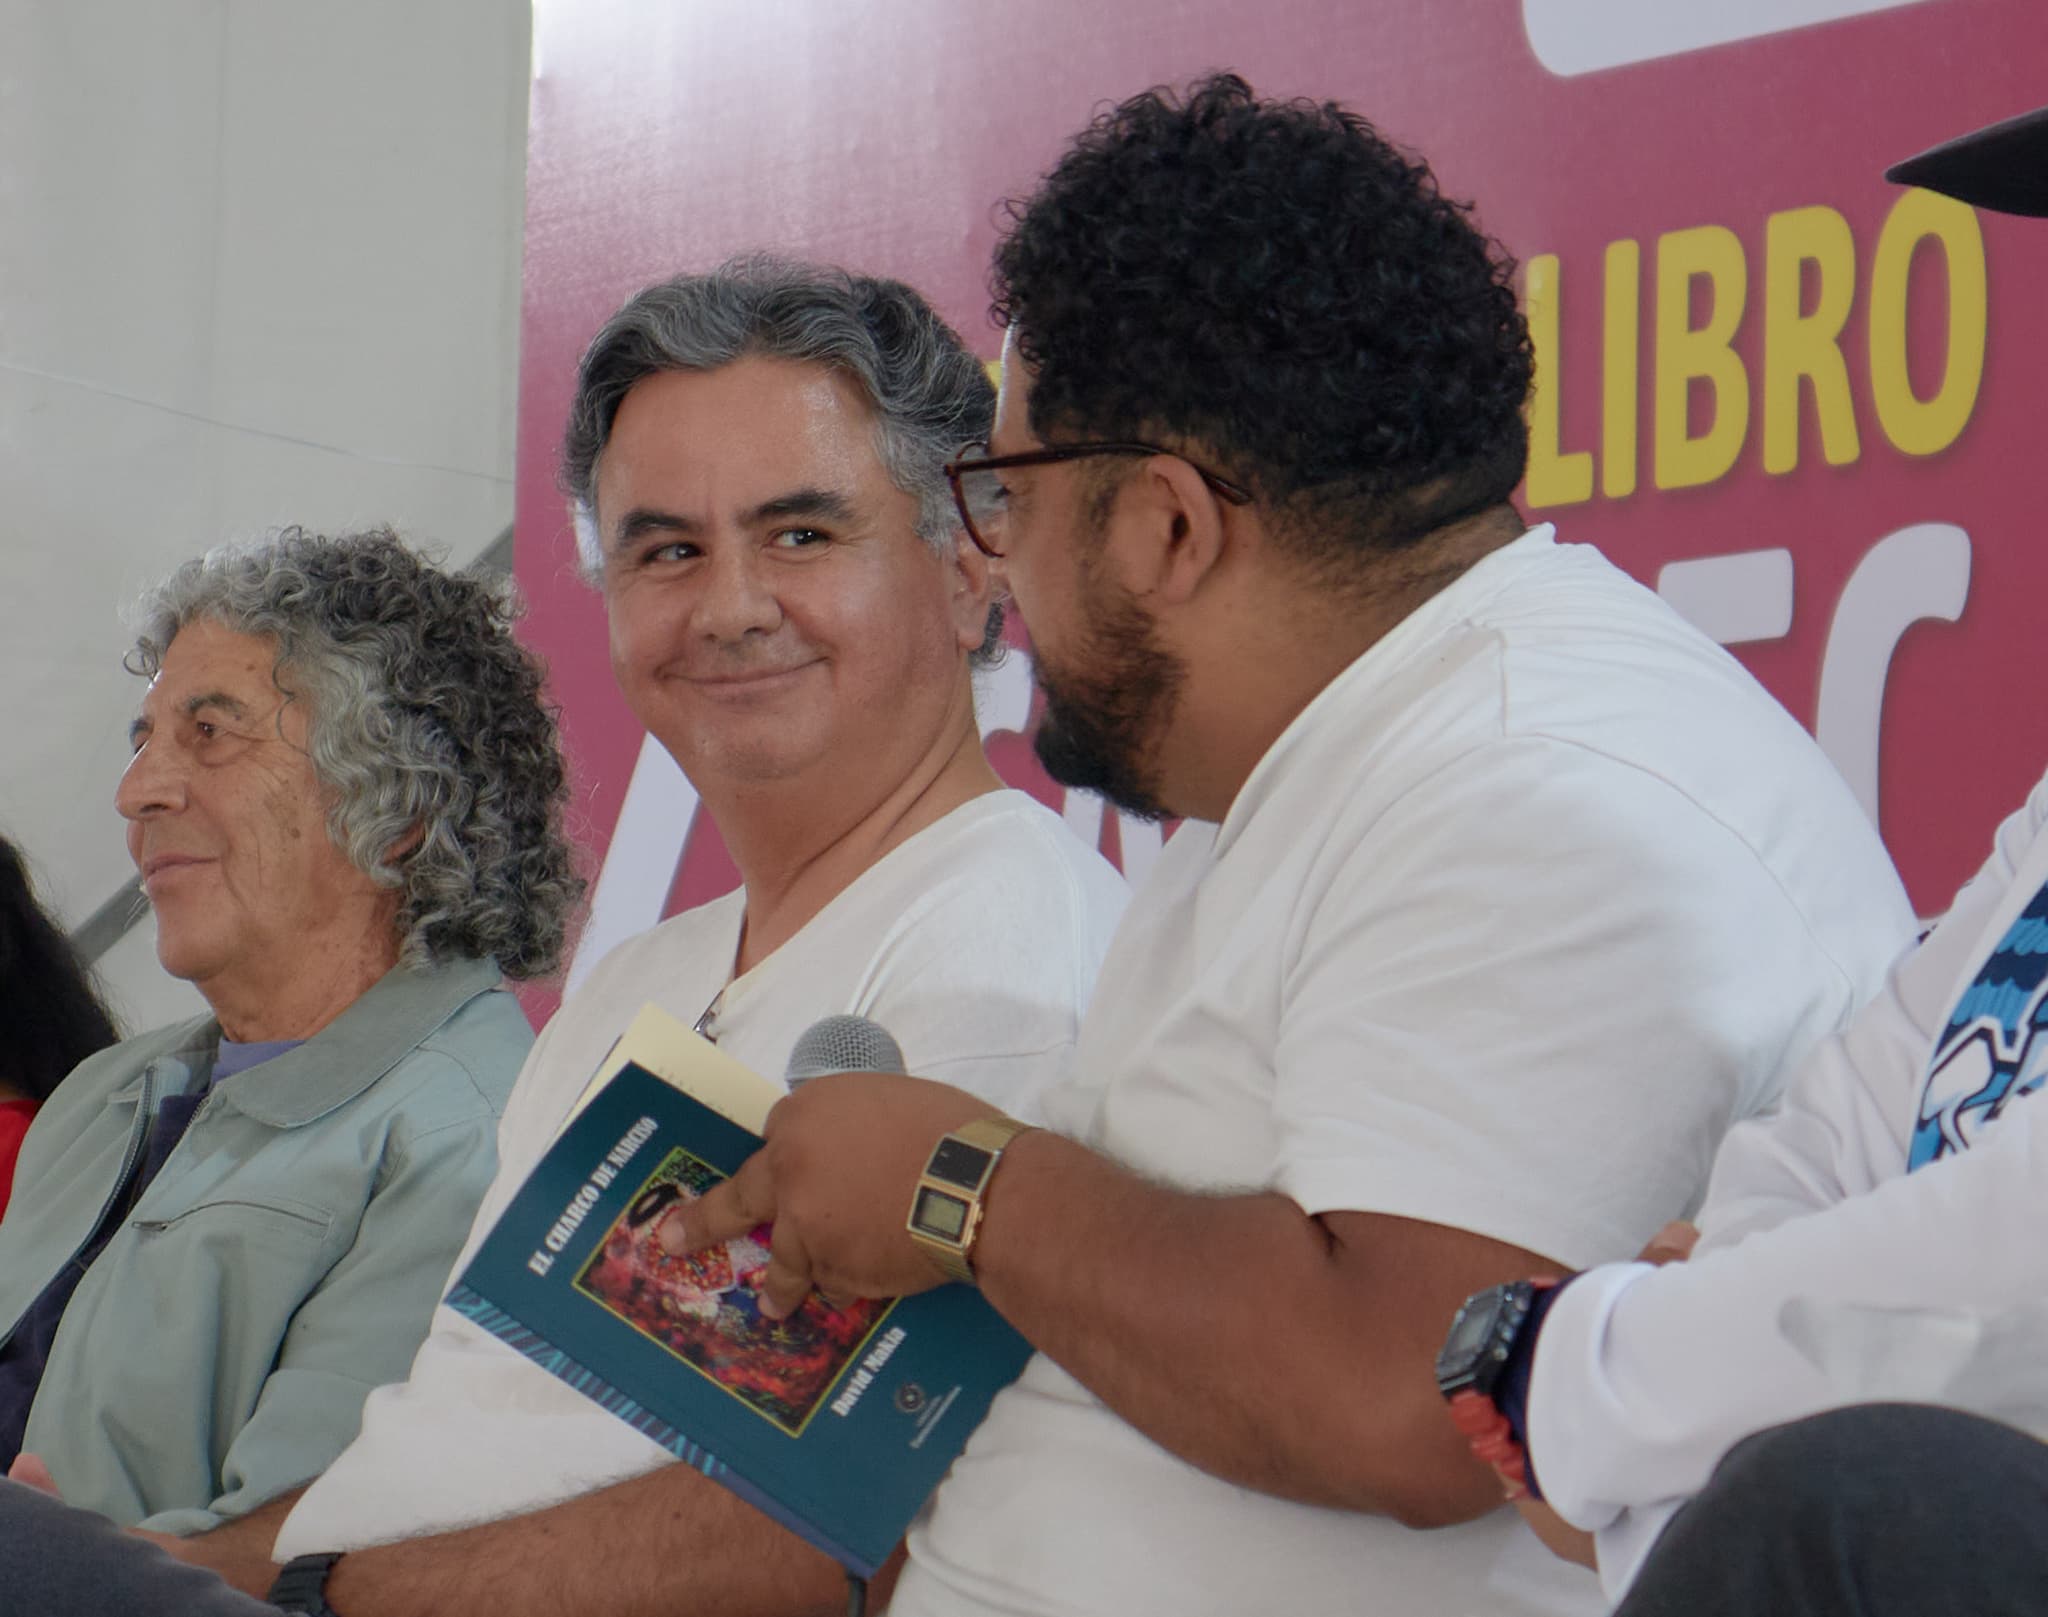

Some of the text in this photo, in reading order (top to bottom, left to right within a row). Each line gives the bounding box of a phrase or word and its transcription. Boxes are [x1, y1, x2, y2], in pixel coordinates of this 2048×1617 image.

[1525, 186, 1987, 508] LIBRO
[527, 1116, 659, 1277] EL CHARCO DE NARCISO
[831, 1368, 874, 1416] David
